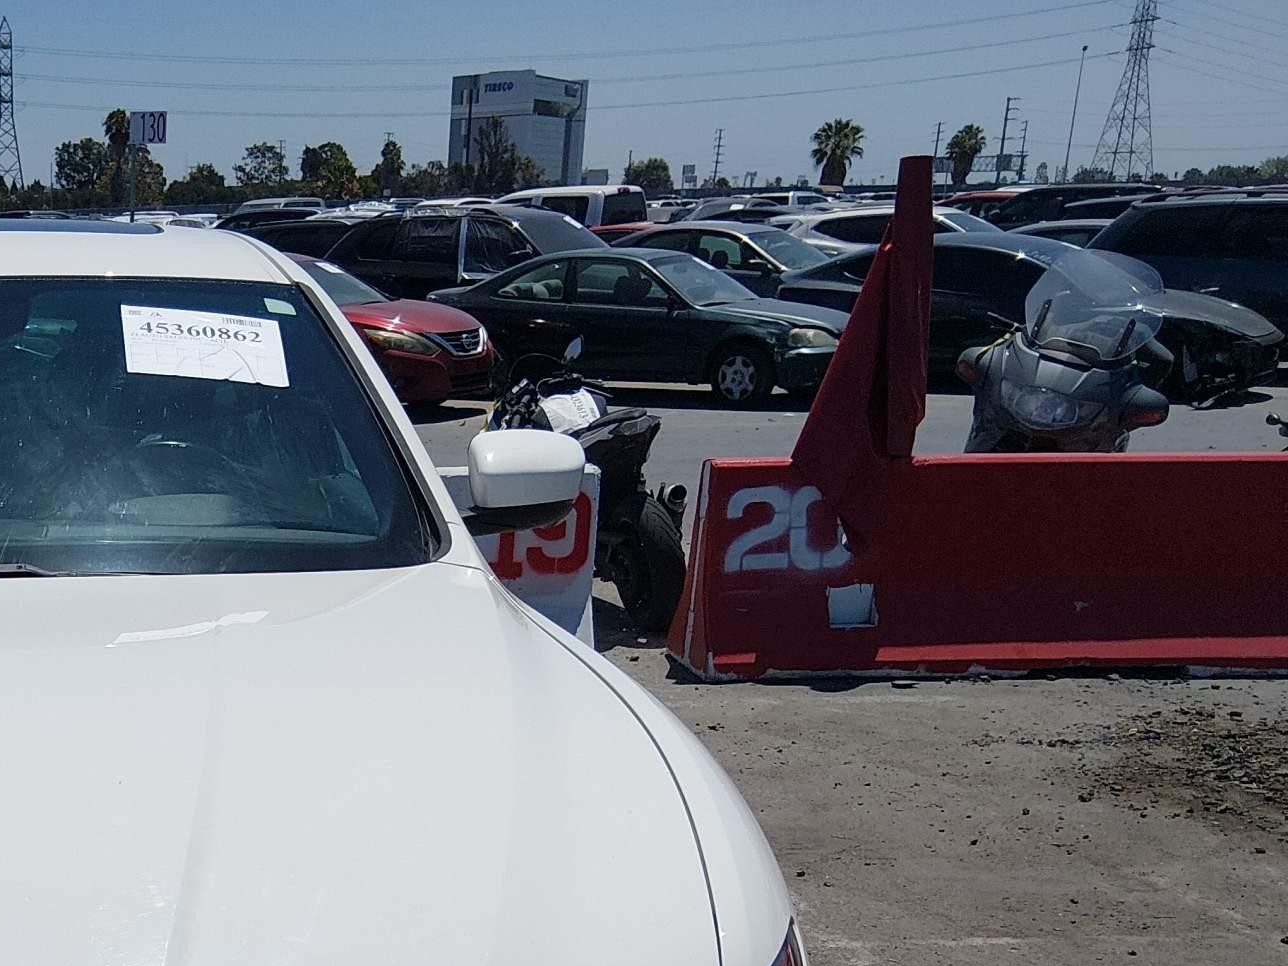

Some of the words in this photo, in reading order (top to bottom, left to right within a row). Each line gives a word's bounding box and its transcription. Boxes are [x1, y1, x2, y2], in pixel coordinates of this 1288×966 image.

[140, 112, 166, 142] 130
[139, 321, 262, 343] 45360862
[724, 485, 852, 573] 20
